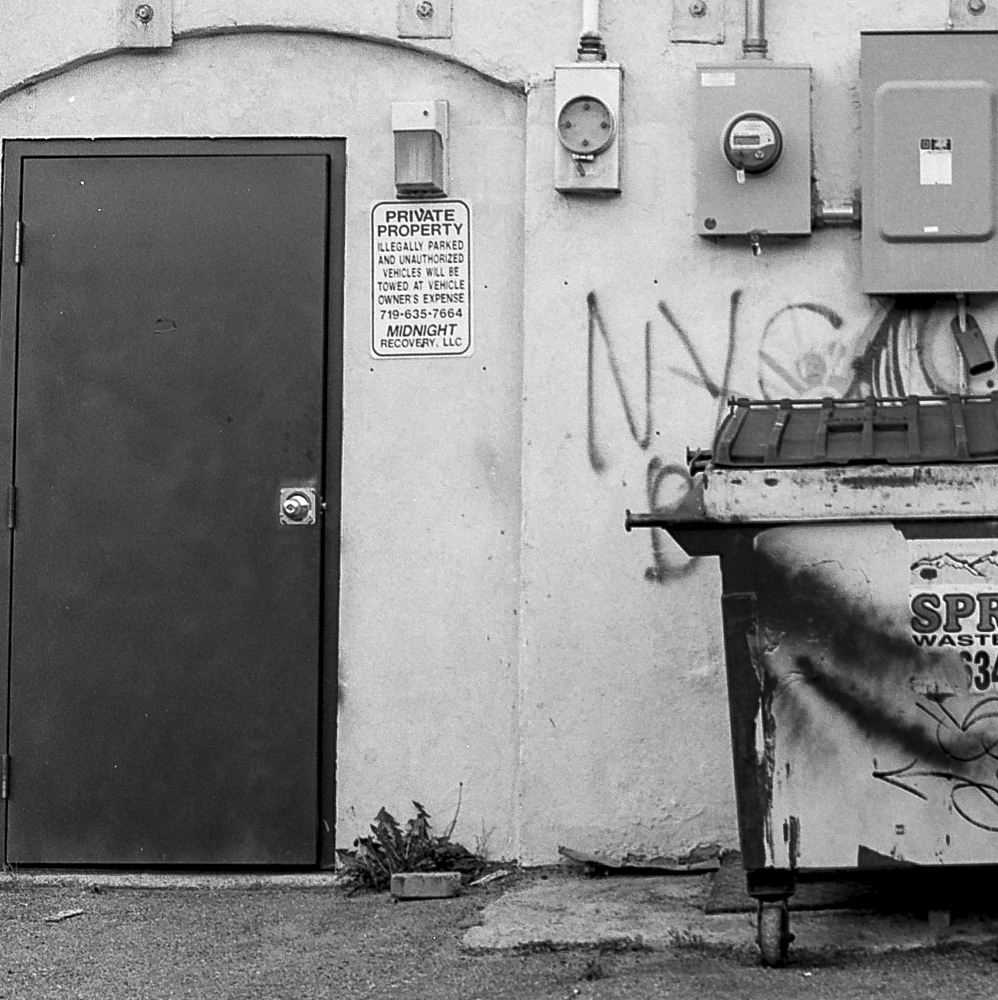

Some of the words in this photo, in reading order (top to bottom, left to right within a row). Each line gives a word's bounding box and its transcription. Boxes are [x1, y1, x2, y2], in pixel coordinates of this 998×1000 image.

[386, 208, 455, 222] PRIVATE
[377, 223, 463, 237] PROPERTY
[377, 241, 423, 252] ILLEGALLY
[428, 240, 464, 250] PARKED
[378, 255, 395, 265] AND
[399, 253, 464, 264] UNAUTHORIZED
[383, 268, 422, 278] VEHICLES
[426, 267, 445, 277] WILL
[449, 267, 459, 276] BE
[377, 281, 409, 291] TOWED
[414, 281, 423, 290] AT
[428, 280, 465, 290] VEHICLE
[423, 293, 464, 304] EXPENSE
[387, 324, 457, 337] MIDNIGHT
[443, 338, 462, 347] LLC
